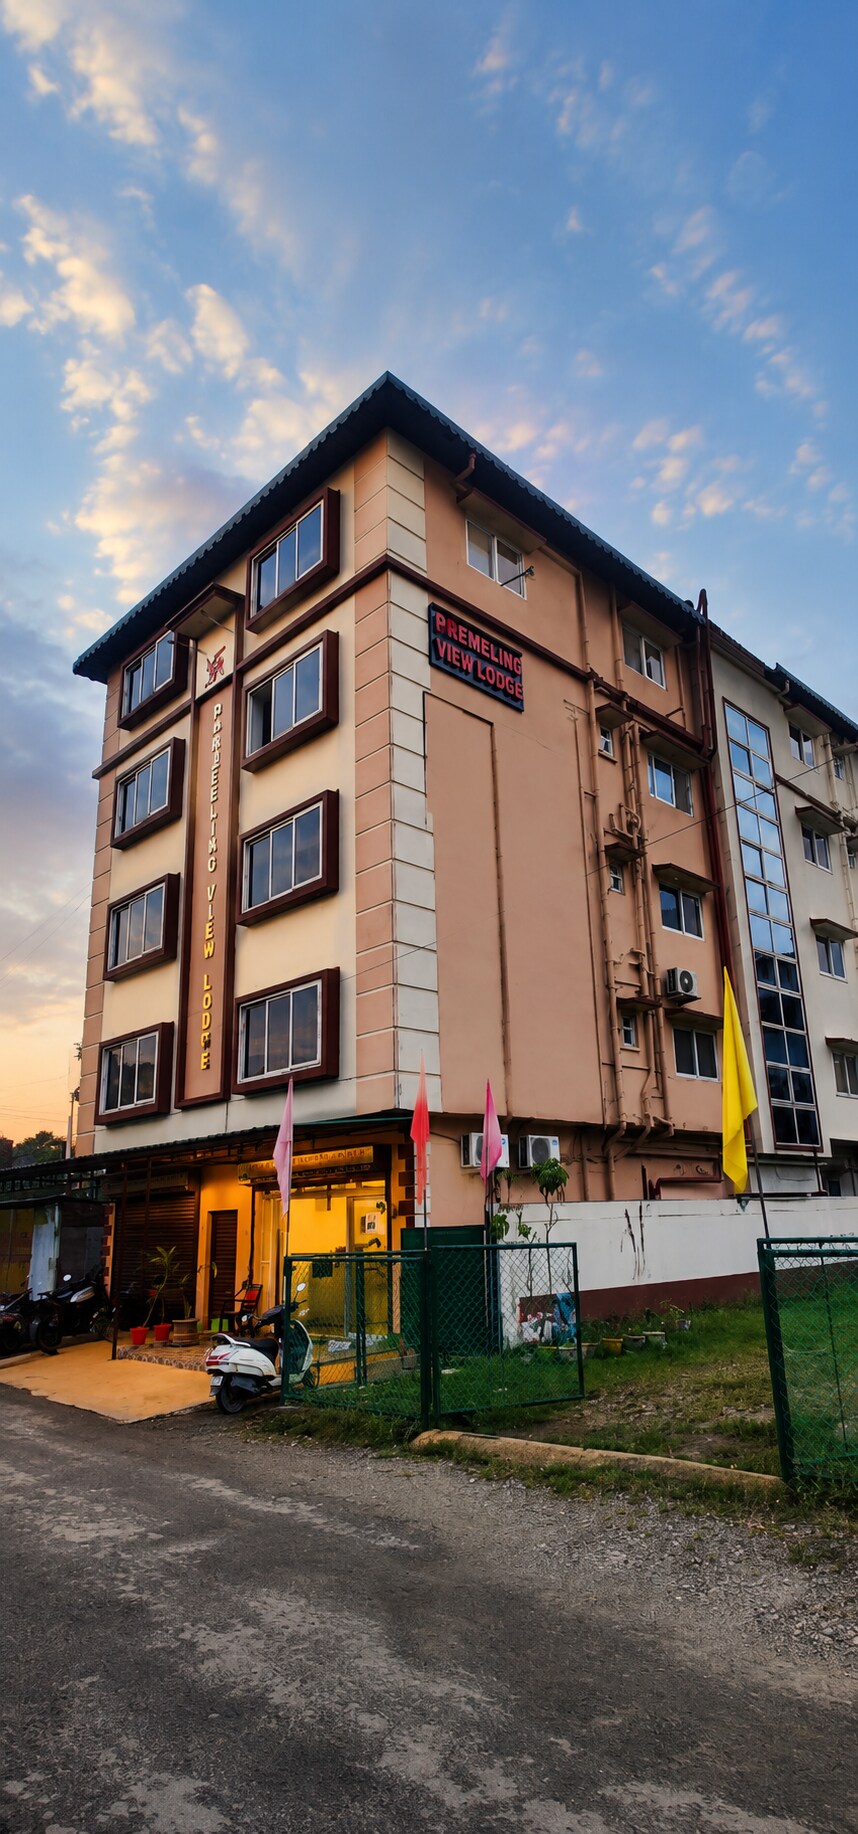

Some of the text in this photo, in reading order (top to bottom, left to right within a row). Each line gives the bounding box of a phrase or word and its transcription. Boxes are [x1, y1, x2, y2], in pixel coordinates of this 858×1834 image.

[435, 612, 522, 676] PREMELING
[436, 637, 524, 700] VIEW LODGE
[204, 884, 216, 959] VIEW
